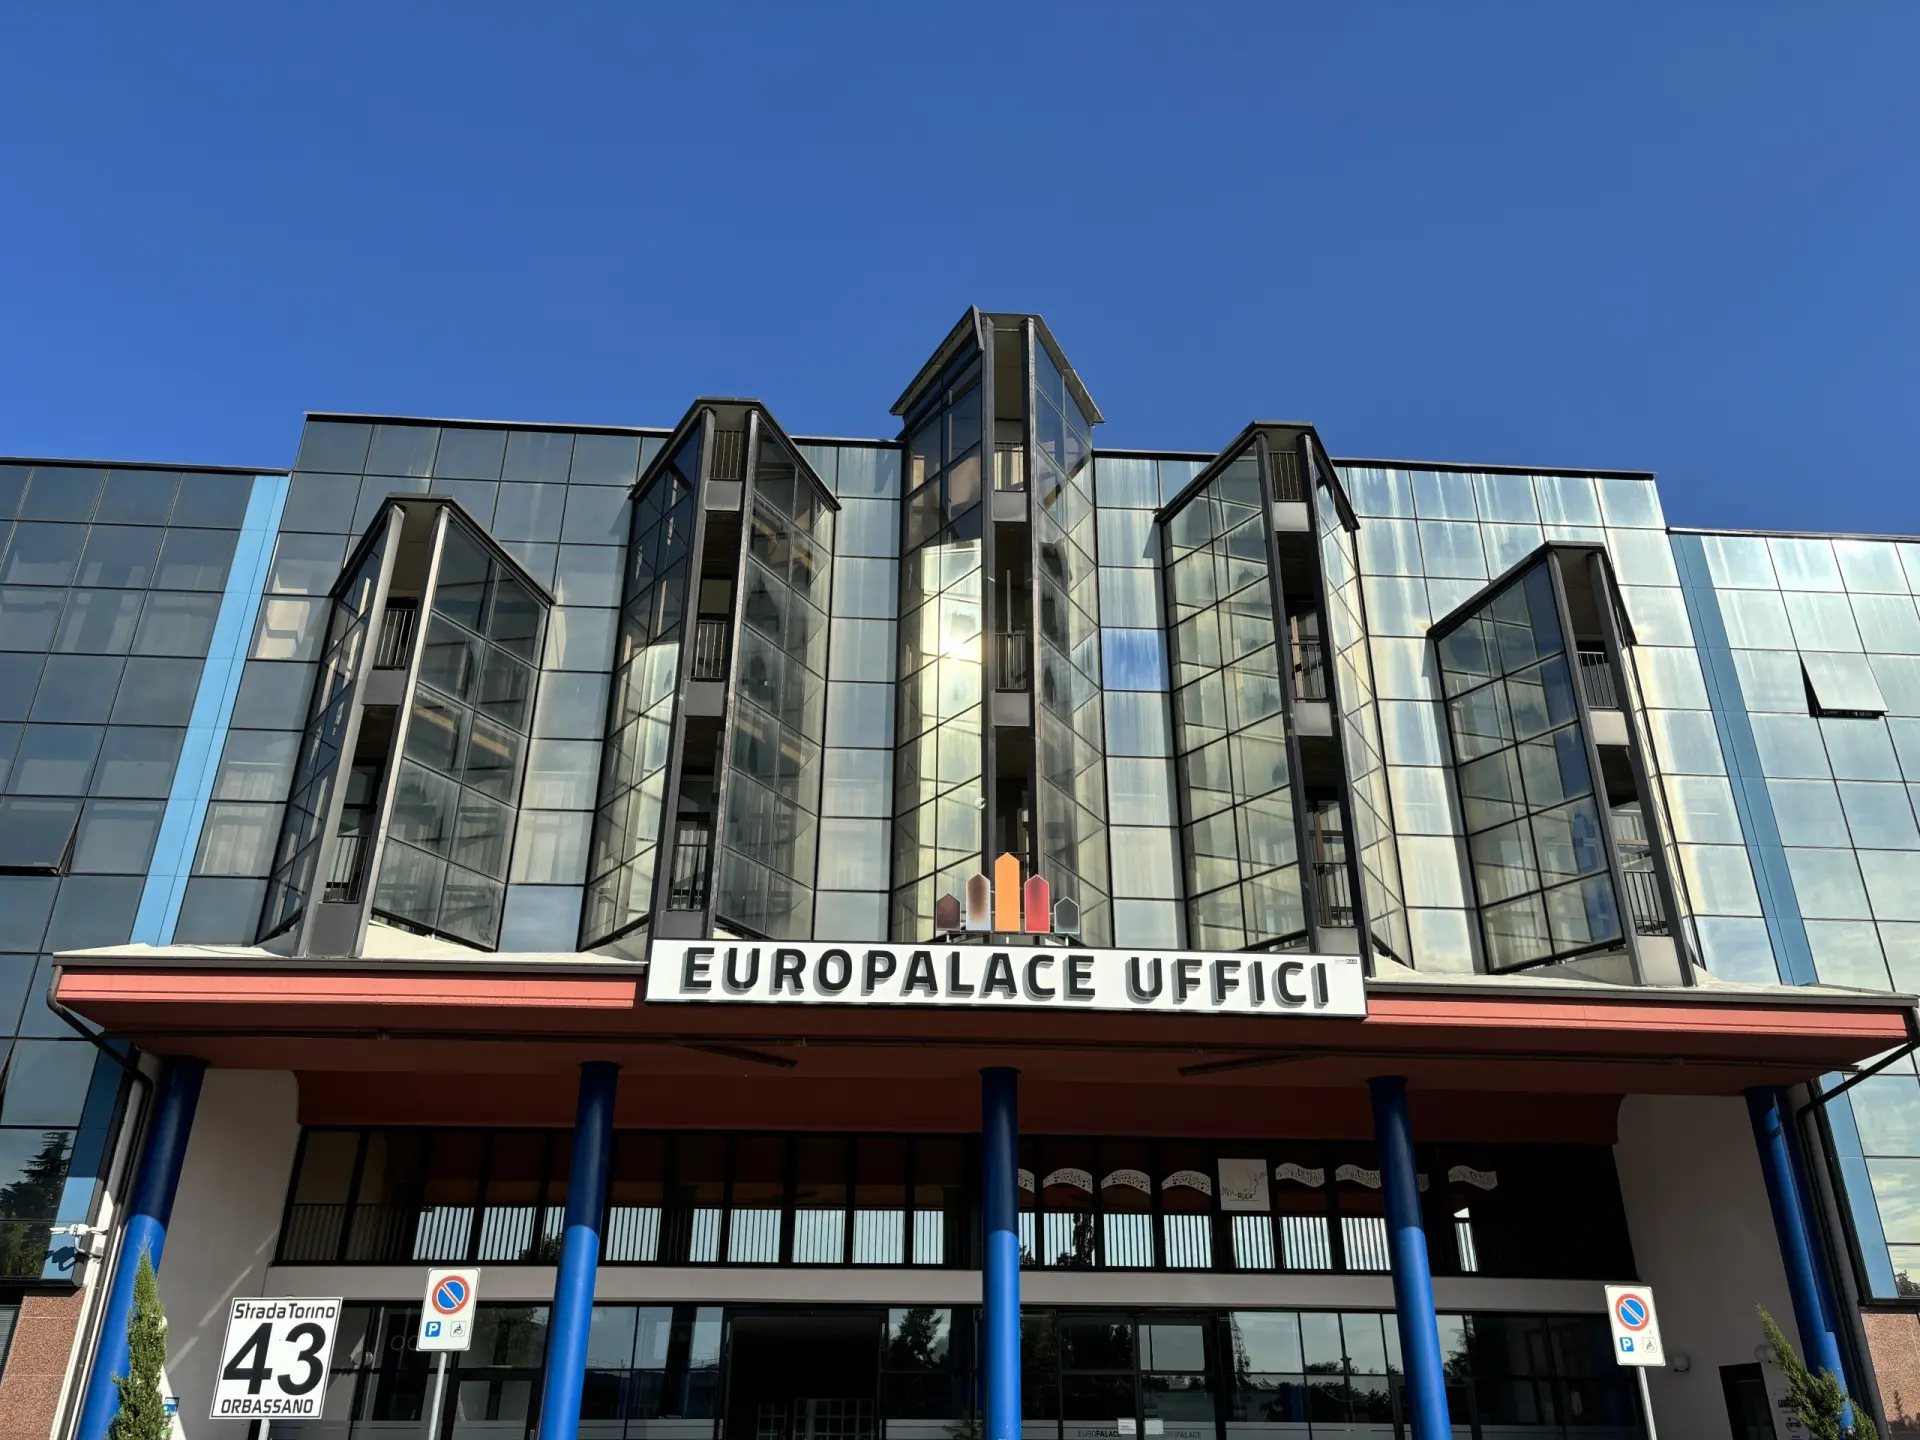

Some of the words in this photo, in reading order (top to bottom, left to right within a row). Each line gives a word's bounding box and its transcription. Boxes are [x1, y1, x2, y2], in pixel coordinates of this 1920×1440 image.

[682, 946, 1096, 999] EUROPALACE
[1128, 956, 1330, 1006] UFFICI
[233, 1302, 286, 1319] Strada
[288, 1302, 336, 1319] Torino
[427, 1322, 440, 1336] P
[1621, 1338, 1633, 1351] P
[222, 1321, 326, 1396] 43
[220, 1398, 314, 1414] ORBASSANO
